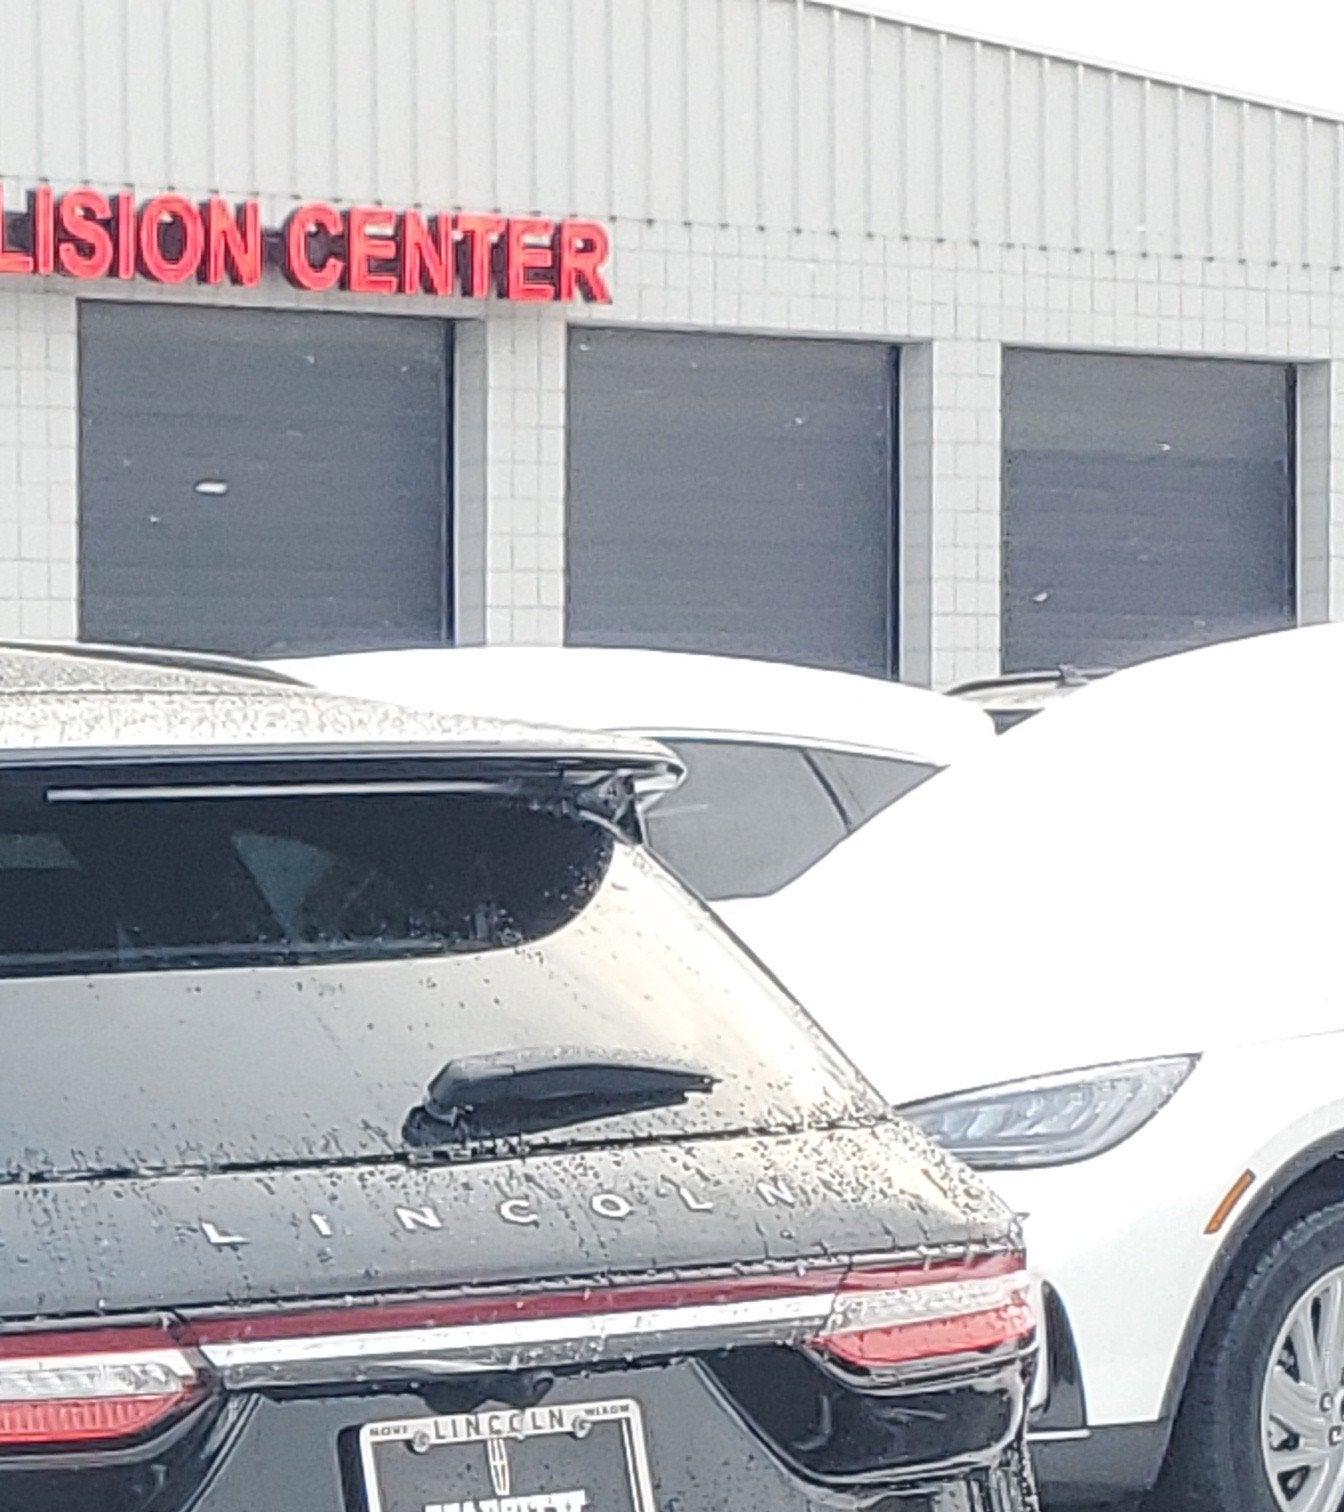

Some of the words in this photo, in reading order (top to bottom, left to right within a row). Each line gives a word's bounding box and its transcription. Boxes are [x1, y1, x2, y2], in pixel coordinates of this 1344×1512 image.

[282, 202, 613, 304] CENTER
[200, 1178, 799, 1245] LINCOLN
[433, 1408, 565, 1440] LINCOLN
